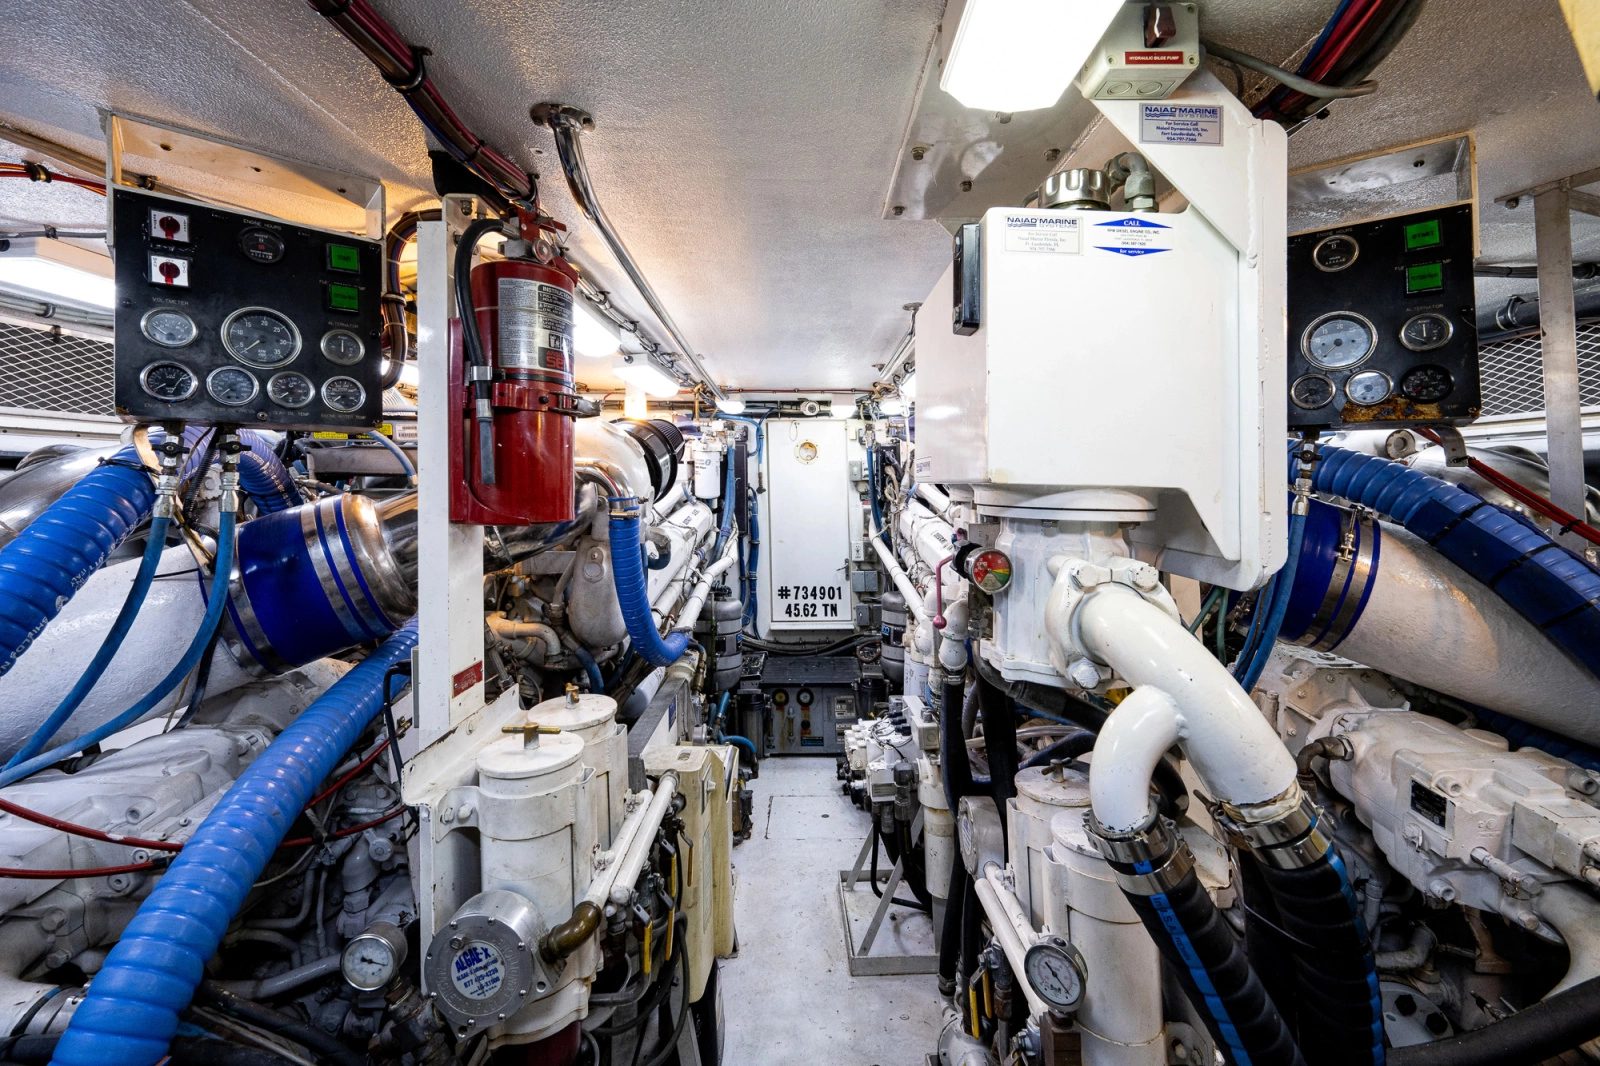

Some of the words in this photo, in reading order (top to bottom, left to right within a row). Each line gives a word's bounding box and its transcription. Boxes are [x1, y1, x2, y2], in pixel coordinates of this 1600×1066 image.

[1179, 107, 1218, 115] MARINE
[152, 296, 189, 306] VOLTMETER
[1405, 303, 1444, 312] ALTERNATOR
[327, 320, 359, 329] ALTERNATOR
[777, 585, 842, 600] #734901
[785, 603, 818, 618] 45.62
[822, 603, 838, 617] TN
[9, 616, 49, 659] SHIELDS
[455, 947, 491, 973] ALGAE-X
